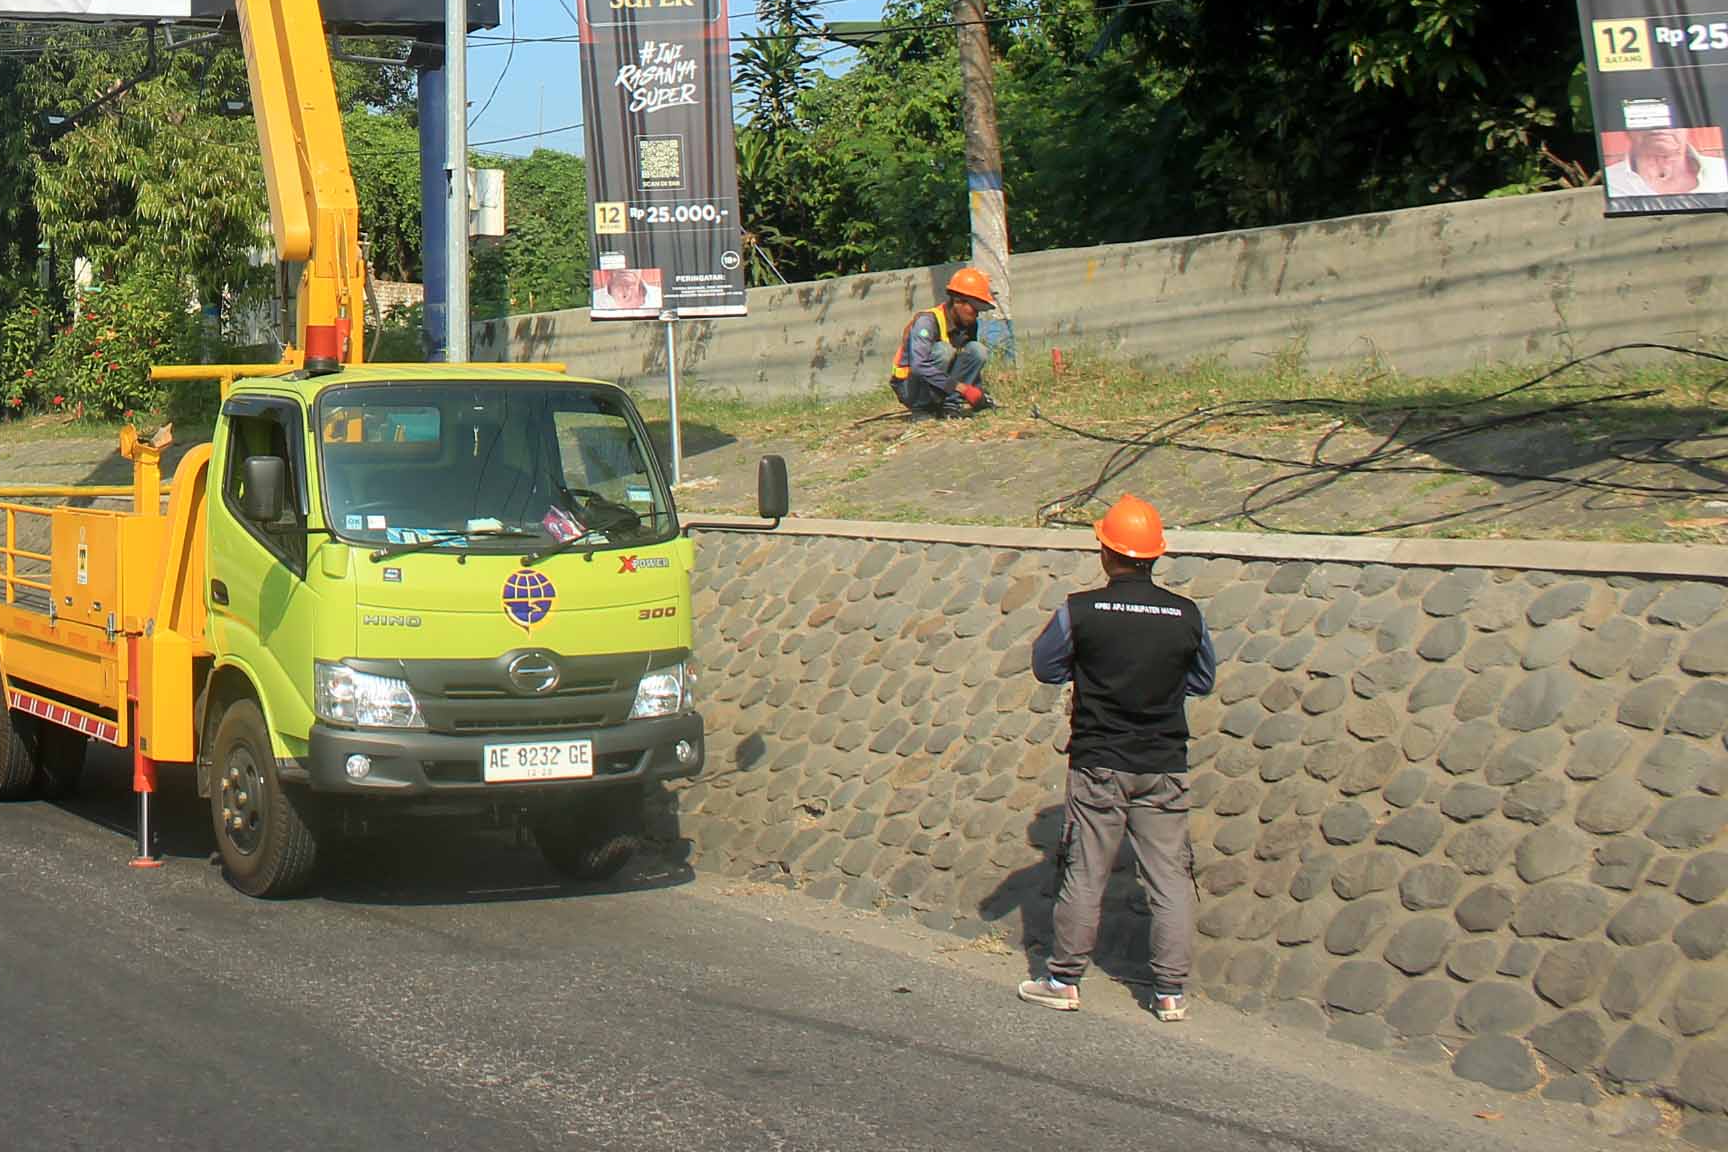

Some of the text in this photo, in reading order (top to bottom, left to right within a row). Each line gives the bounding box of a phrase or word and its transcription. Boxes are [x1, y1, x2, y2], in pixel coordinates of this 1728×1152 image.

[1602, 26, 1641, 54] 12
[1655, 26, 1684, 47] Rp
[638, 41, 685, 66] #INI
[614, 59, 699, 92] RASANYA
[629, 83, 701, 112] SUPER
[599, 207, 620, 224] 12
[629, 204, 729, 224] Rp 25.000,-
[363, 615, 422, 627] HINO
[638, 606, 676, 620] 300
[489, 744, 589, 768] AE 8232 GE
